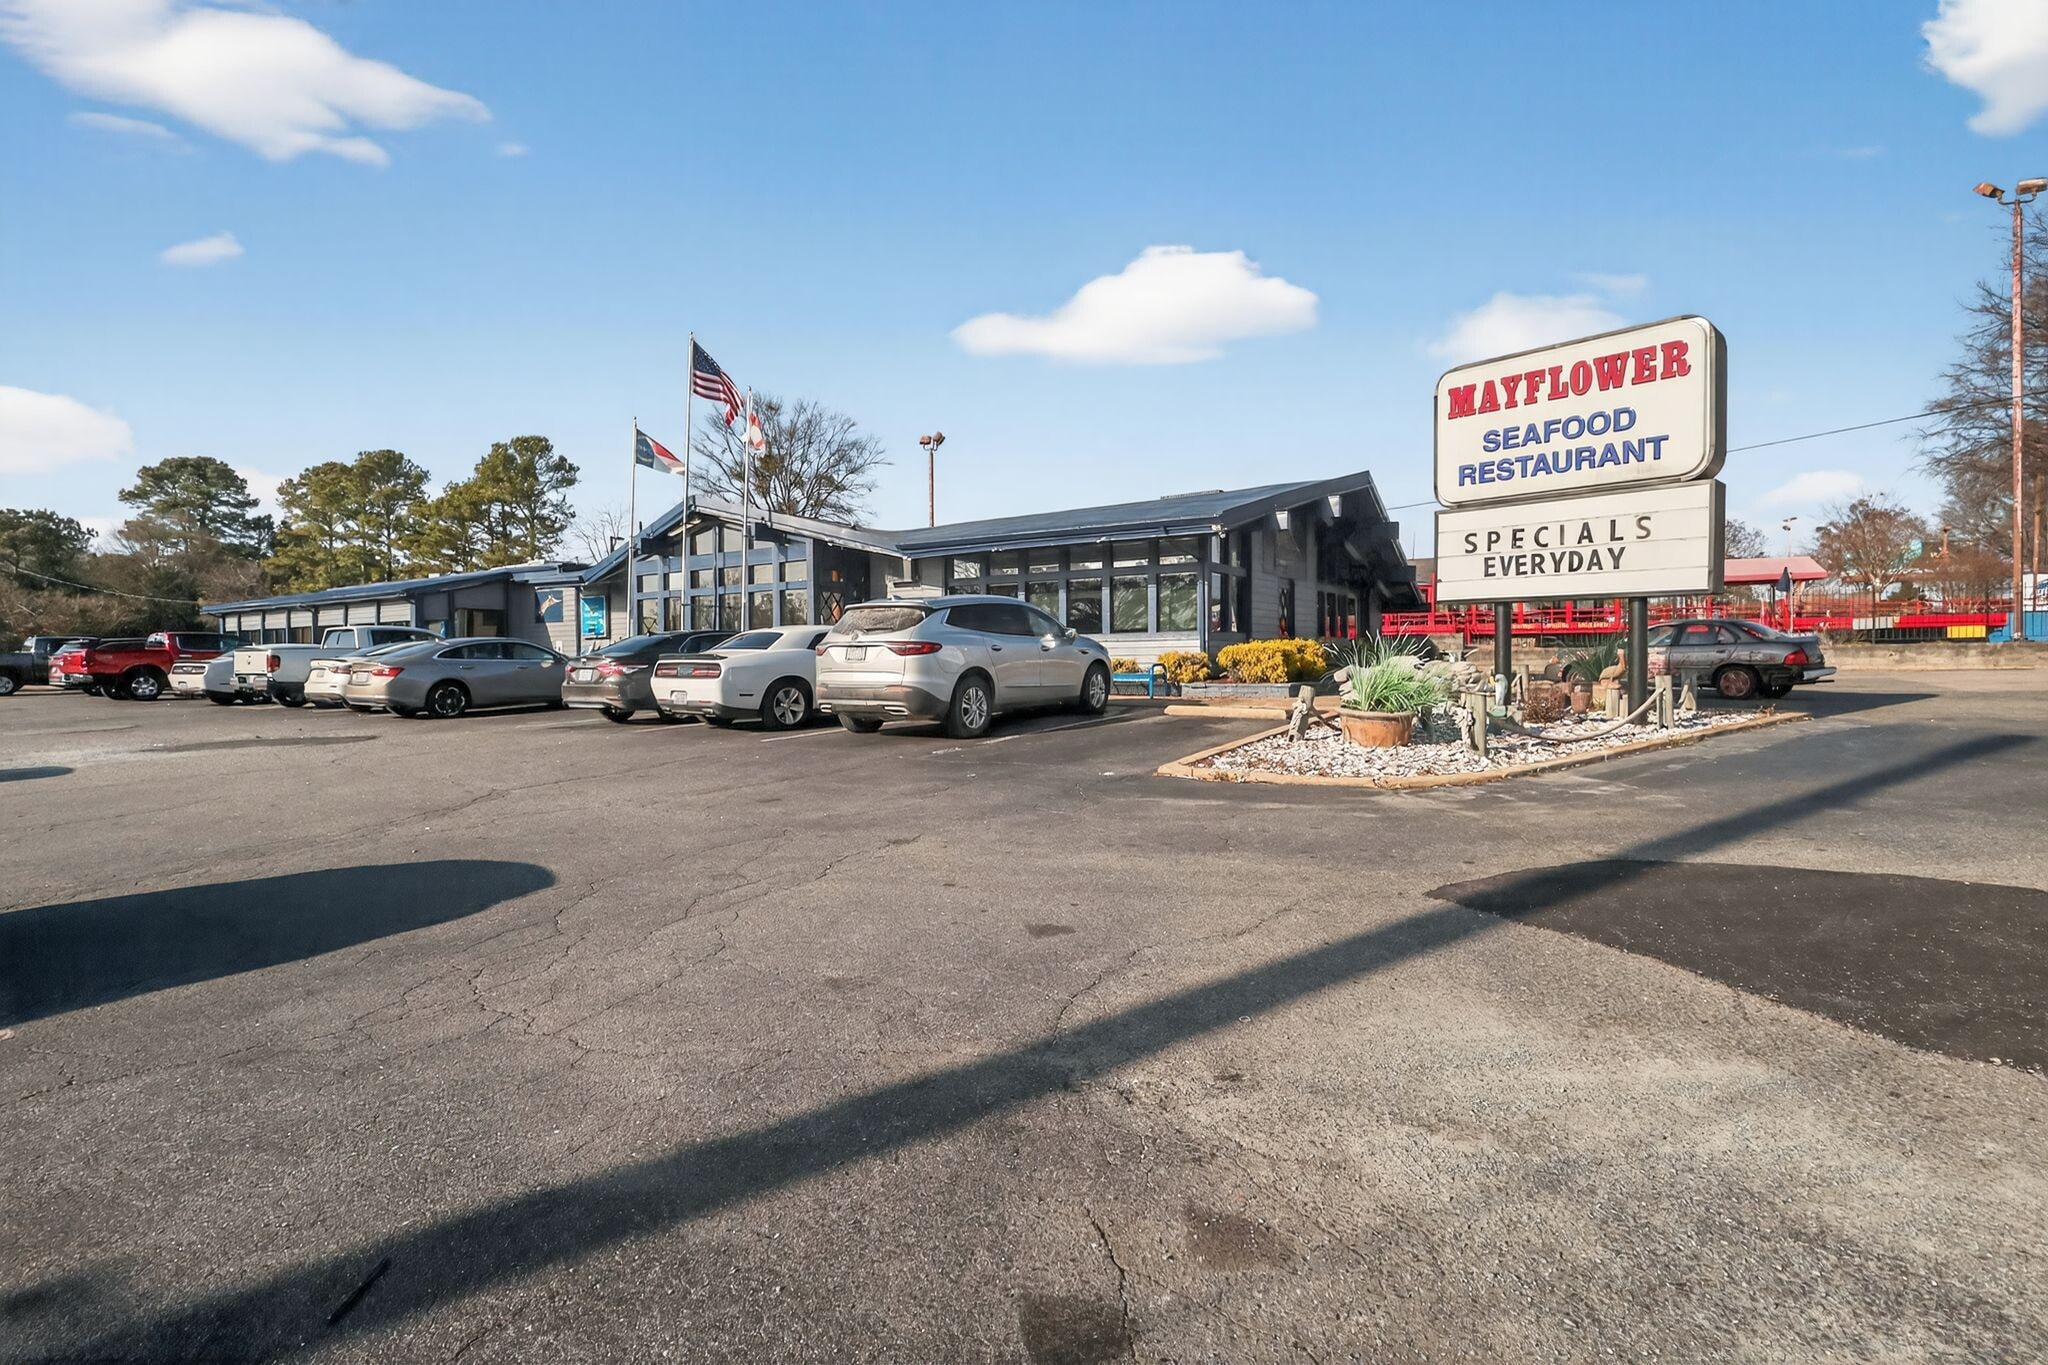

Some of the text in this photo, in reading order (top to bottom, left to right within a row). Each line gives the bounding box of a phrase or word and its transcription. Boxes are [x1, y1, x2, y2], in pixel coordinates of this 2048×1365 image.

[1448, 340, 1691, 420] MAYFLOWER
[1483, 407, 1636, 452] SEAFOOD
[1458, 435, 1669, 487] RESTAURANT
[1464, 515, 1652, 554] SPECIALS
[1483, 547, 1626, 578] EVERYDAY
